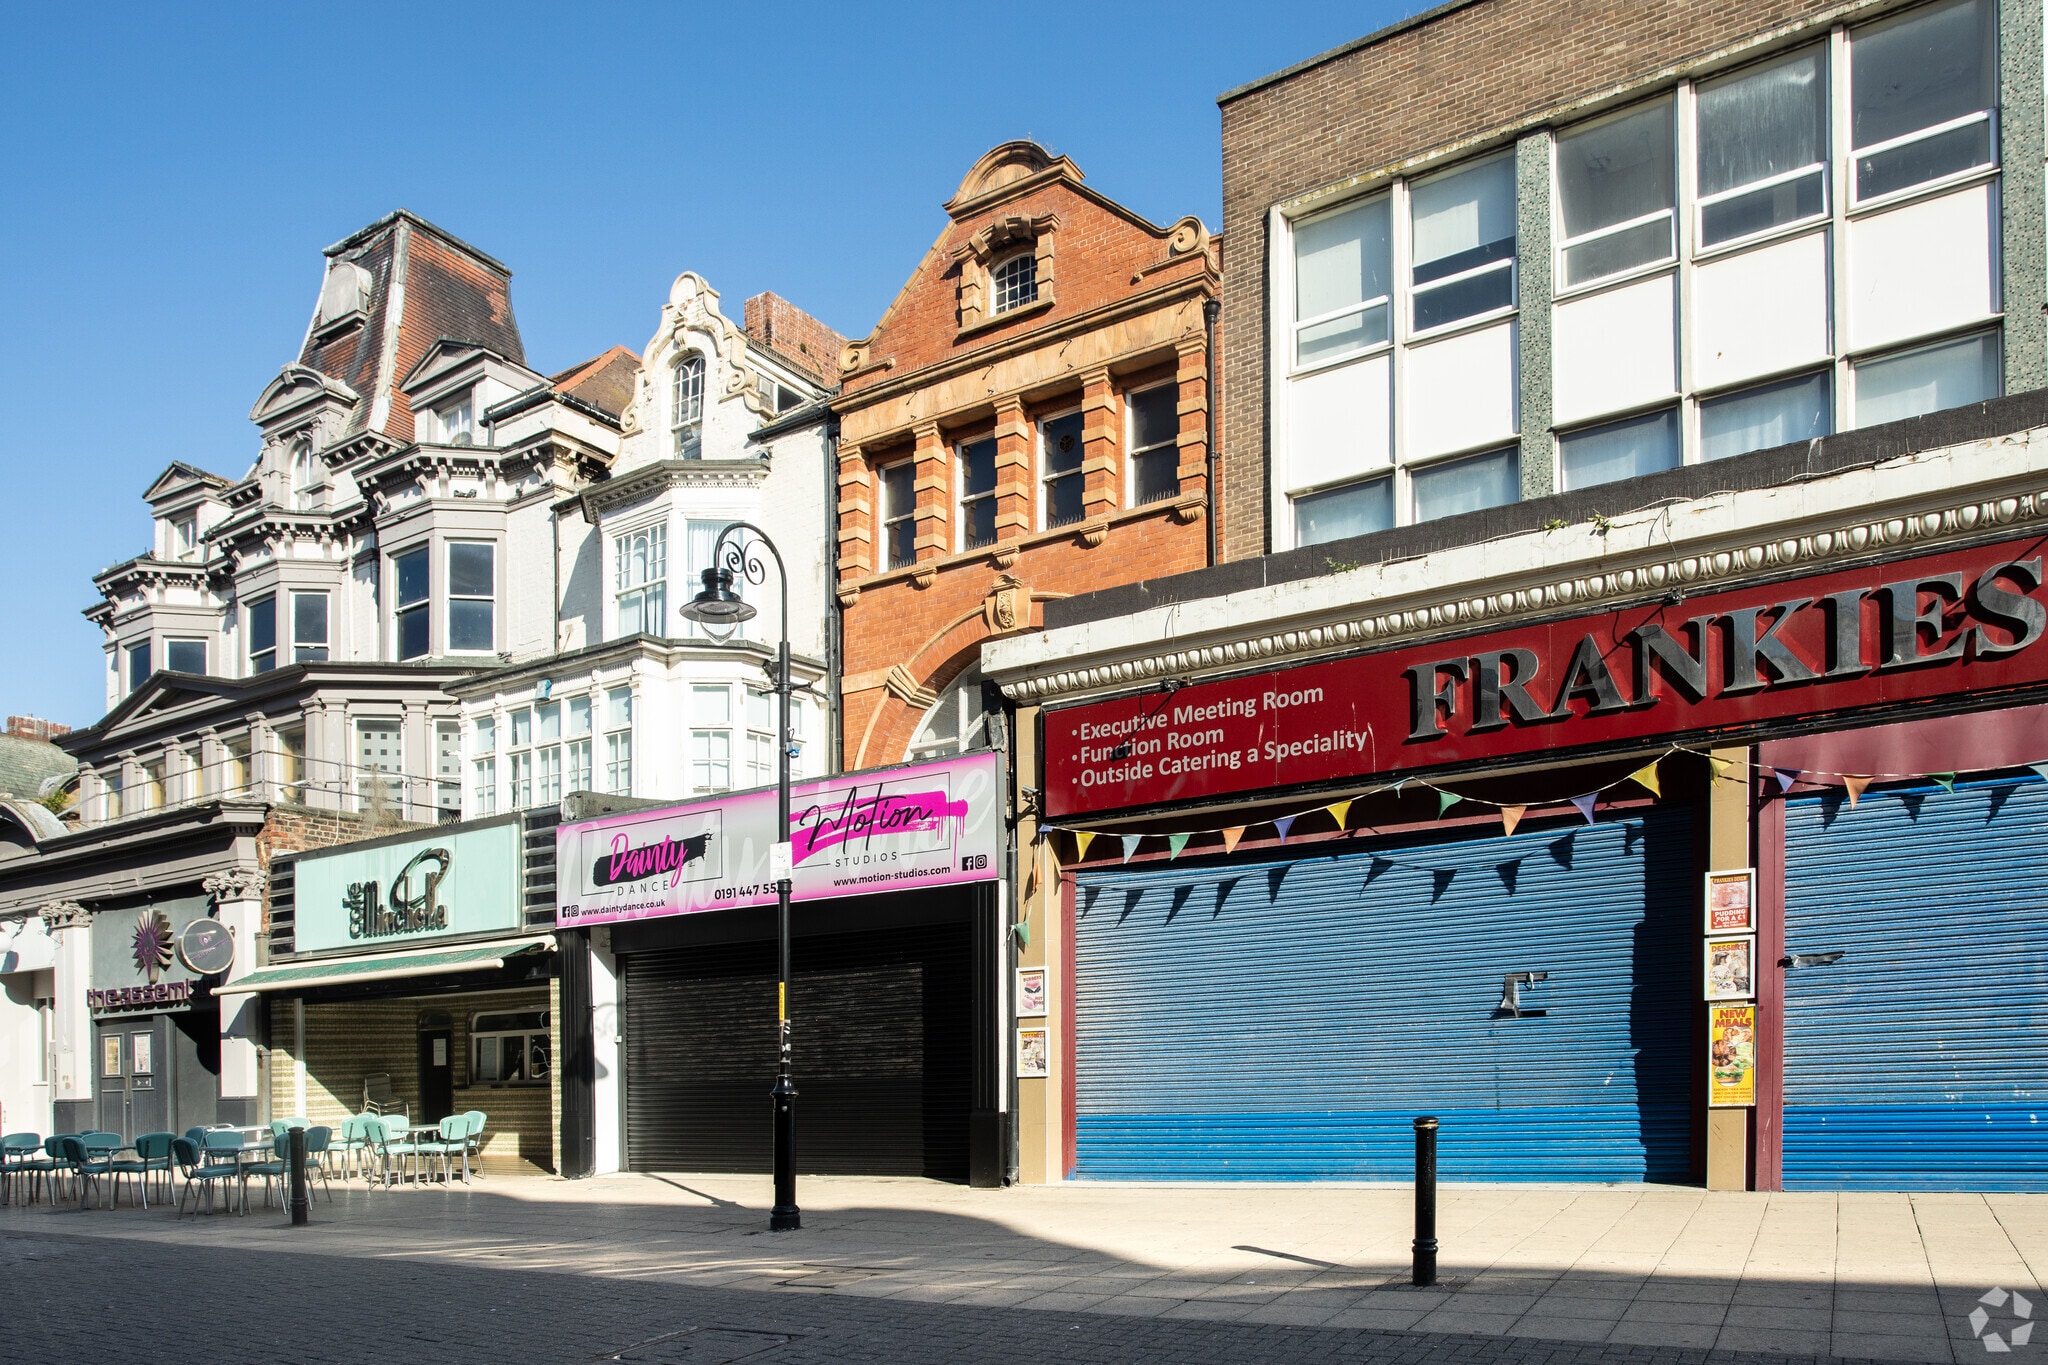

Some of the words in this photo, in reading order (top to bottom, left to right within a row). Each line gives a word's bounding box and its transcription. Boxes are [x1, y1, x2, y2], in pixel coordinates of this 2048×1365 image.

[1407, 555, 2047, 739] FRANKIES
[1079, 711, 1168, 742] Executive
[1173, 697, 1256, 726] Meeting
[1262, 687, 1324, 711] Room
[1079, 738, 1161, 764] Function
[1166, 728, 1225, 752] Room
[1080, 757, 1153, 787] Outside
[1158, 748, 1242, 777] Catering
[1246, 747, 1259, 763] a
[1263, 729, 1369, 763] Speciality
[800, 782, 933, 854] Motion
[609, 832, 689, 888] Dainty
[834, 851, 898, 868] STUDIOS
[833, 865, 951, 887] www.motion-studios.com
[617, 881, 669, 897] DANCE
[714, 887, 737, 901] 0191
[739, 884, 760, 898] 447
[762, 882, 777, 895] 55
[580, 898, 666, 917] www.daintydance.co.uk
[1714, 908, 1746, 918] PUDDING
[1711, 943, 1748, 953] DESSERTS
[1714, 1017, 1752, 1028] MEALS
[1719, 1008, 1748, 1019] NEW
